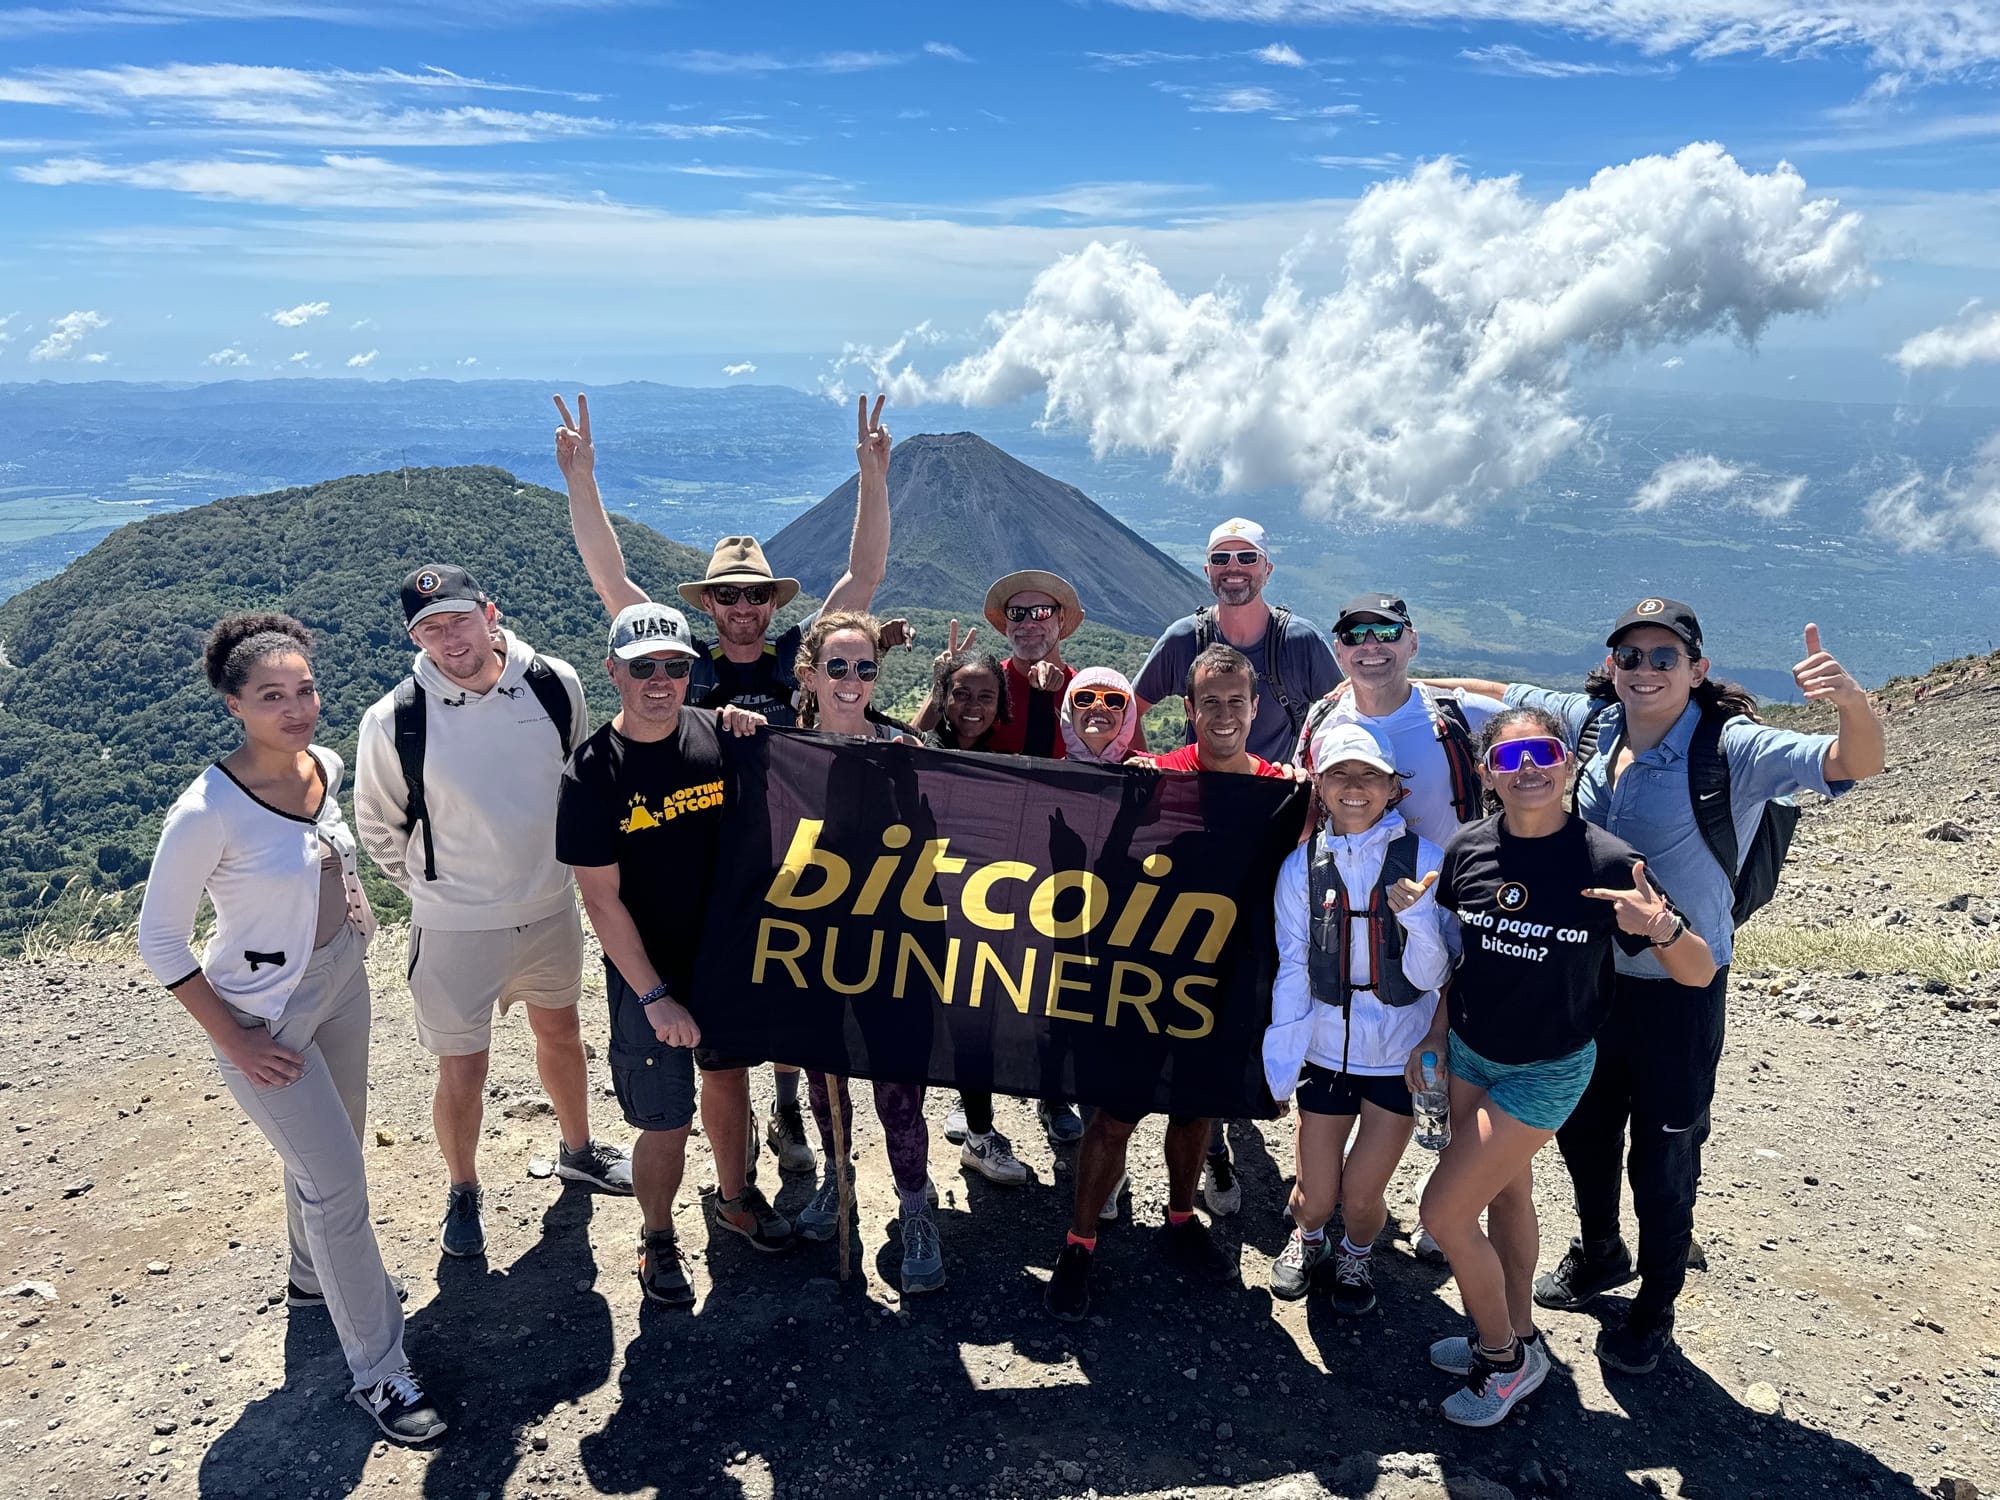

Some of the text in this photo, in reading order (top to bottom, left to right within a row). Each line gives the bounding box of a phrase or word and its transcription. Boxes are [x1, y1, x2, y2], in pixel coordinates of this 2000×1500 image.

[664, 780, 724, 808] AOPTIN
[764, 817, 1238, 964] bitcoin
[1496, 917, 1554, 938] pagar
[1556, 928, 1589, 943] con
[1481, 934, 1549, 962] bitcoin?
[751, 918, 1219, 1039] RUNNERS
